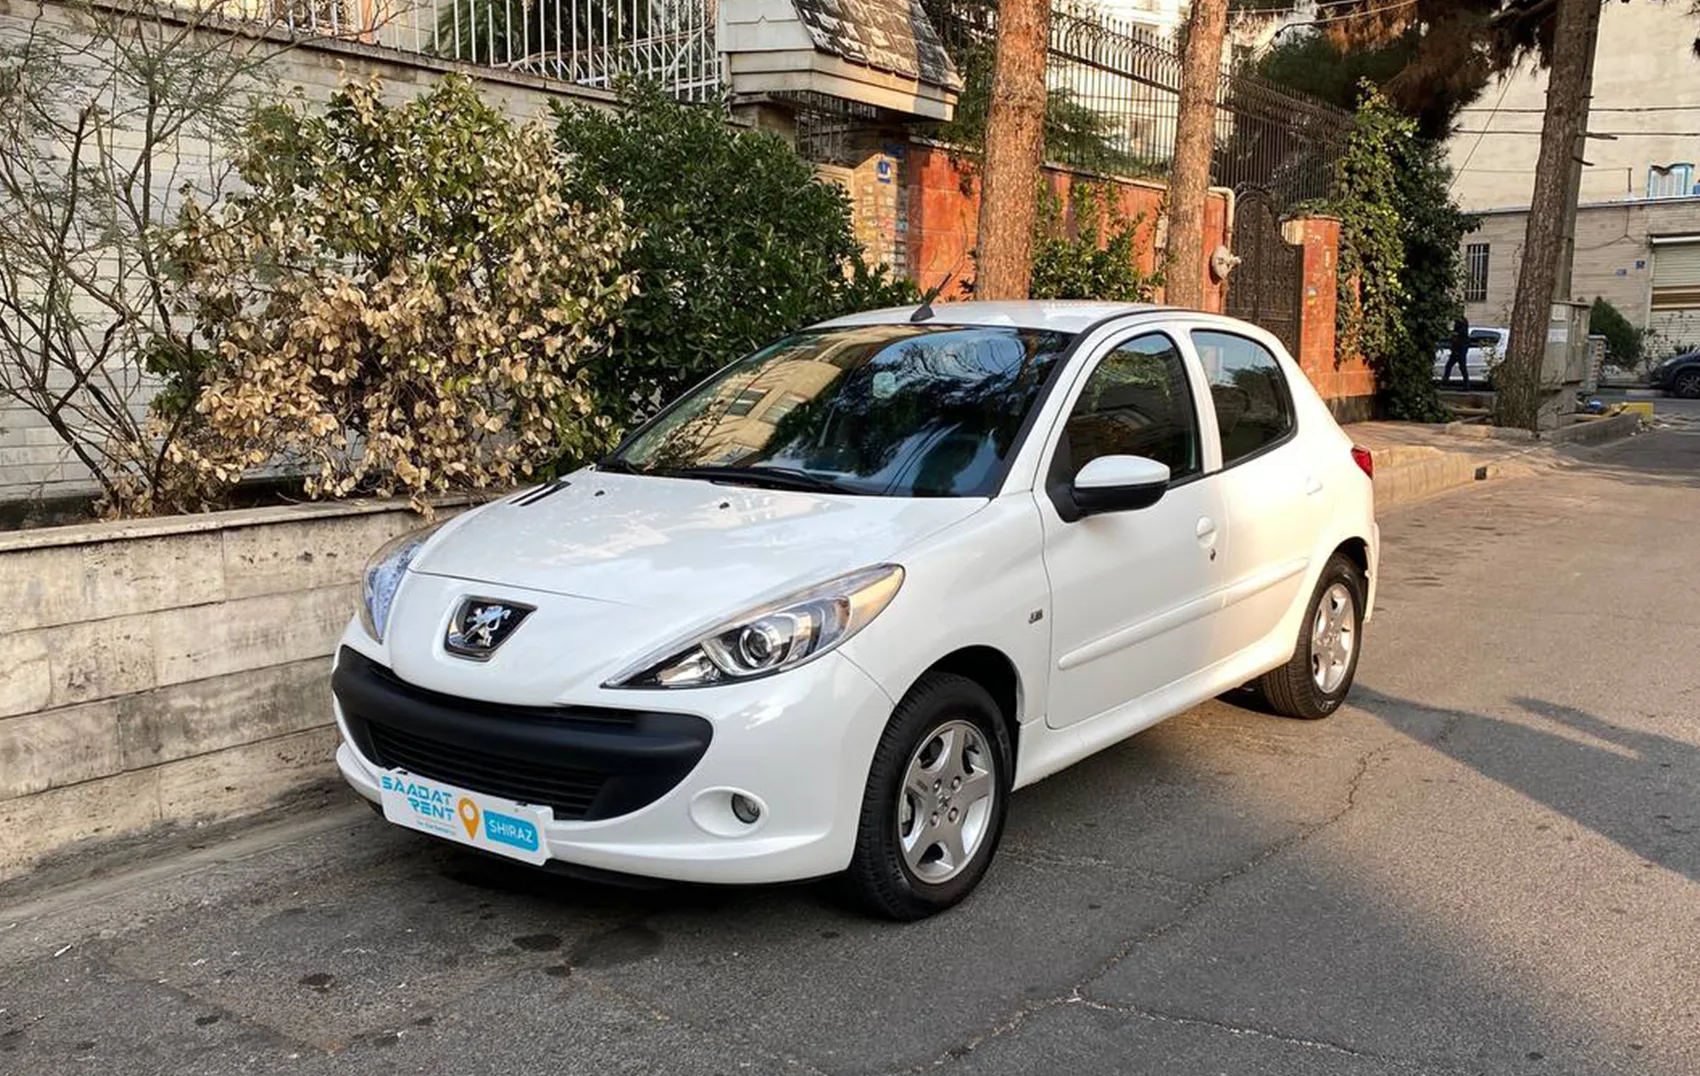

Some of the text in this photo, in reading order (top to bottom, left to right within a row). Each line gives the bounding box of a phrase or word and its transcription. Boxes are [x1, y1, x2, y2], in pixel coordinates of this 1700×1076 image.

[381, 776, 452, 806] SAADAT
[408, 798, 456, 821] RENT
[489, 820, 533, 843] SHIRAZ
